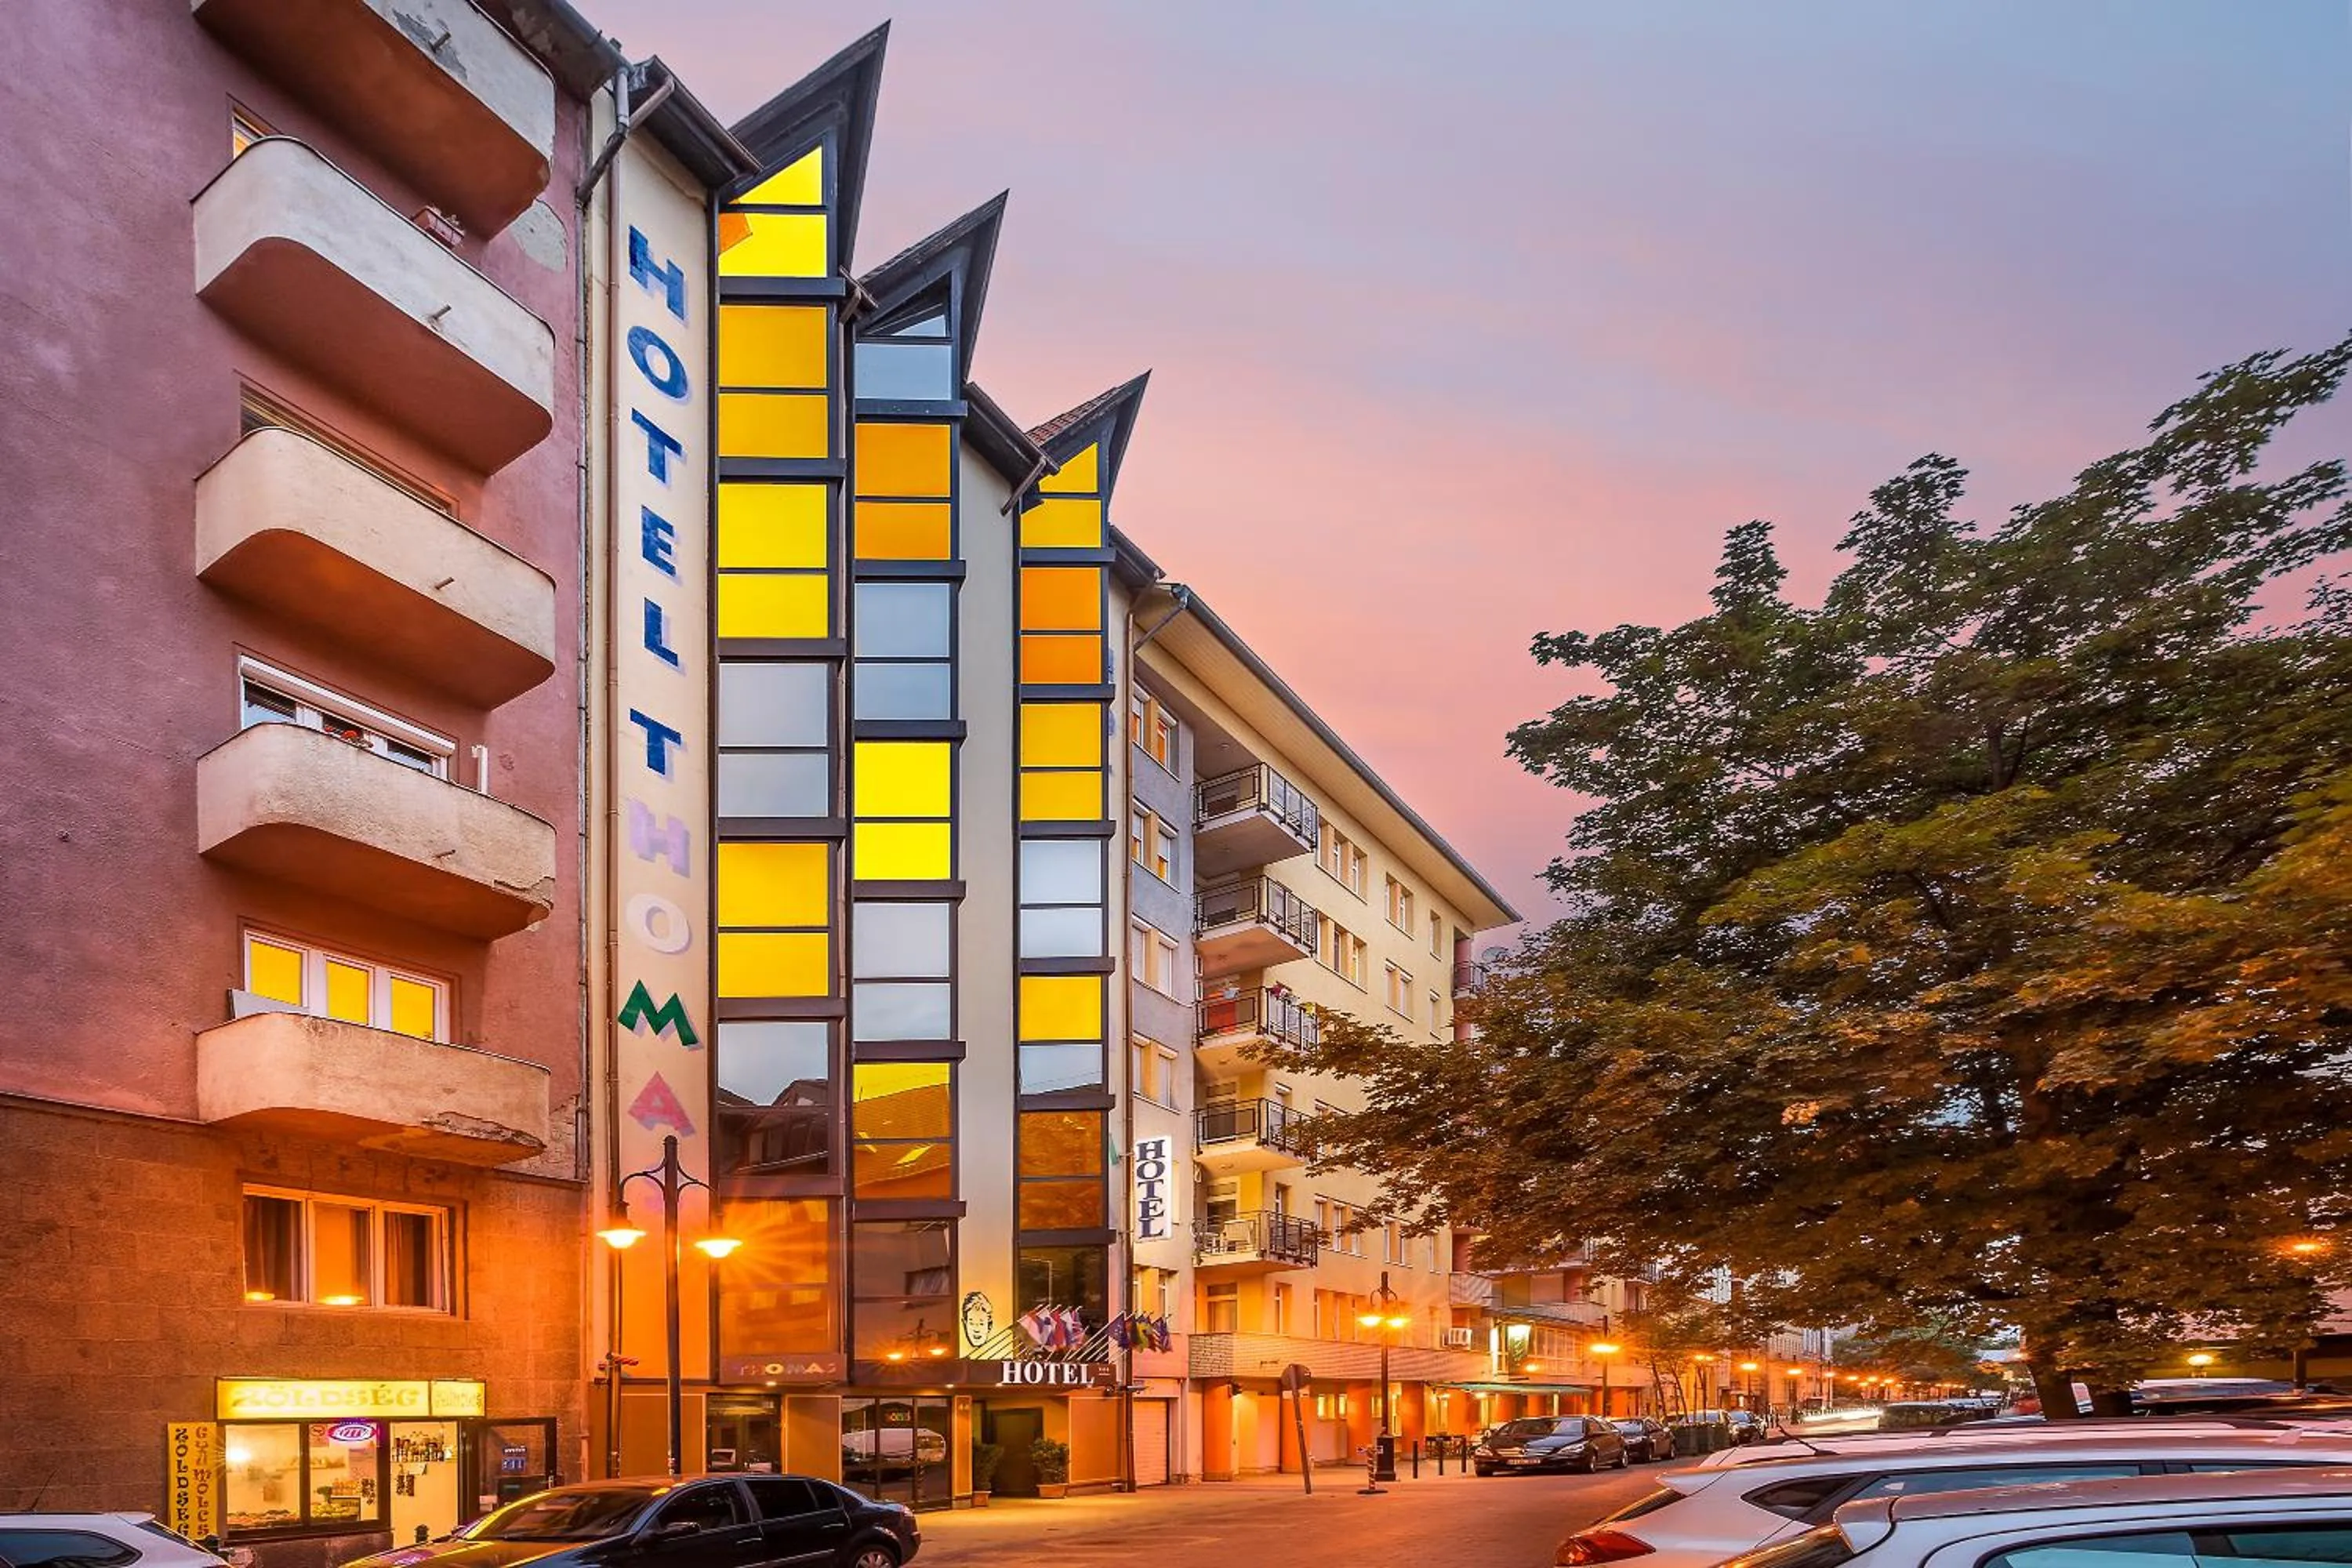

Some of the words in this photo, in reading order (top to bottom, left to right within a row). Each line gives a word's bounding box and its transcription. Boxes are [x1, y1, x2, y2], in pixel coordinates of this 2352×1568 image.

[627, 225, 690, 667] HOTEL
[1136, 1139, 1166, 1239] HOTEL
[232, 1384, 420, 1406] ZÖLDSÉG
[1002, 1360, 1094, 1385] HOTEL
